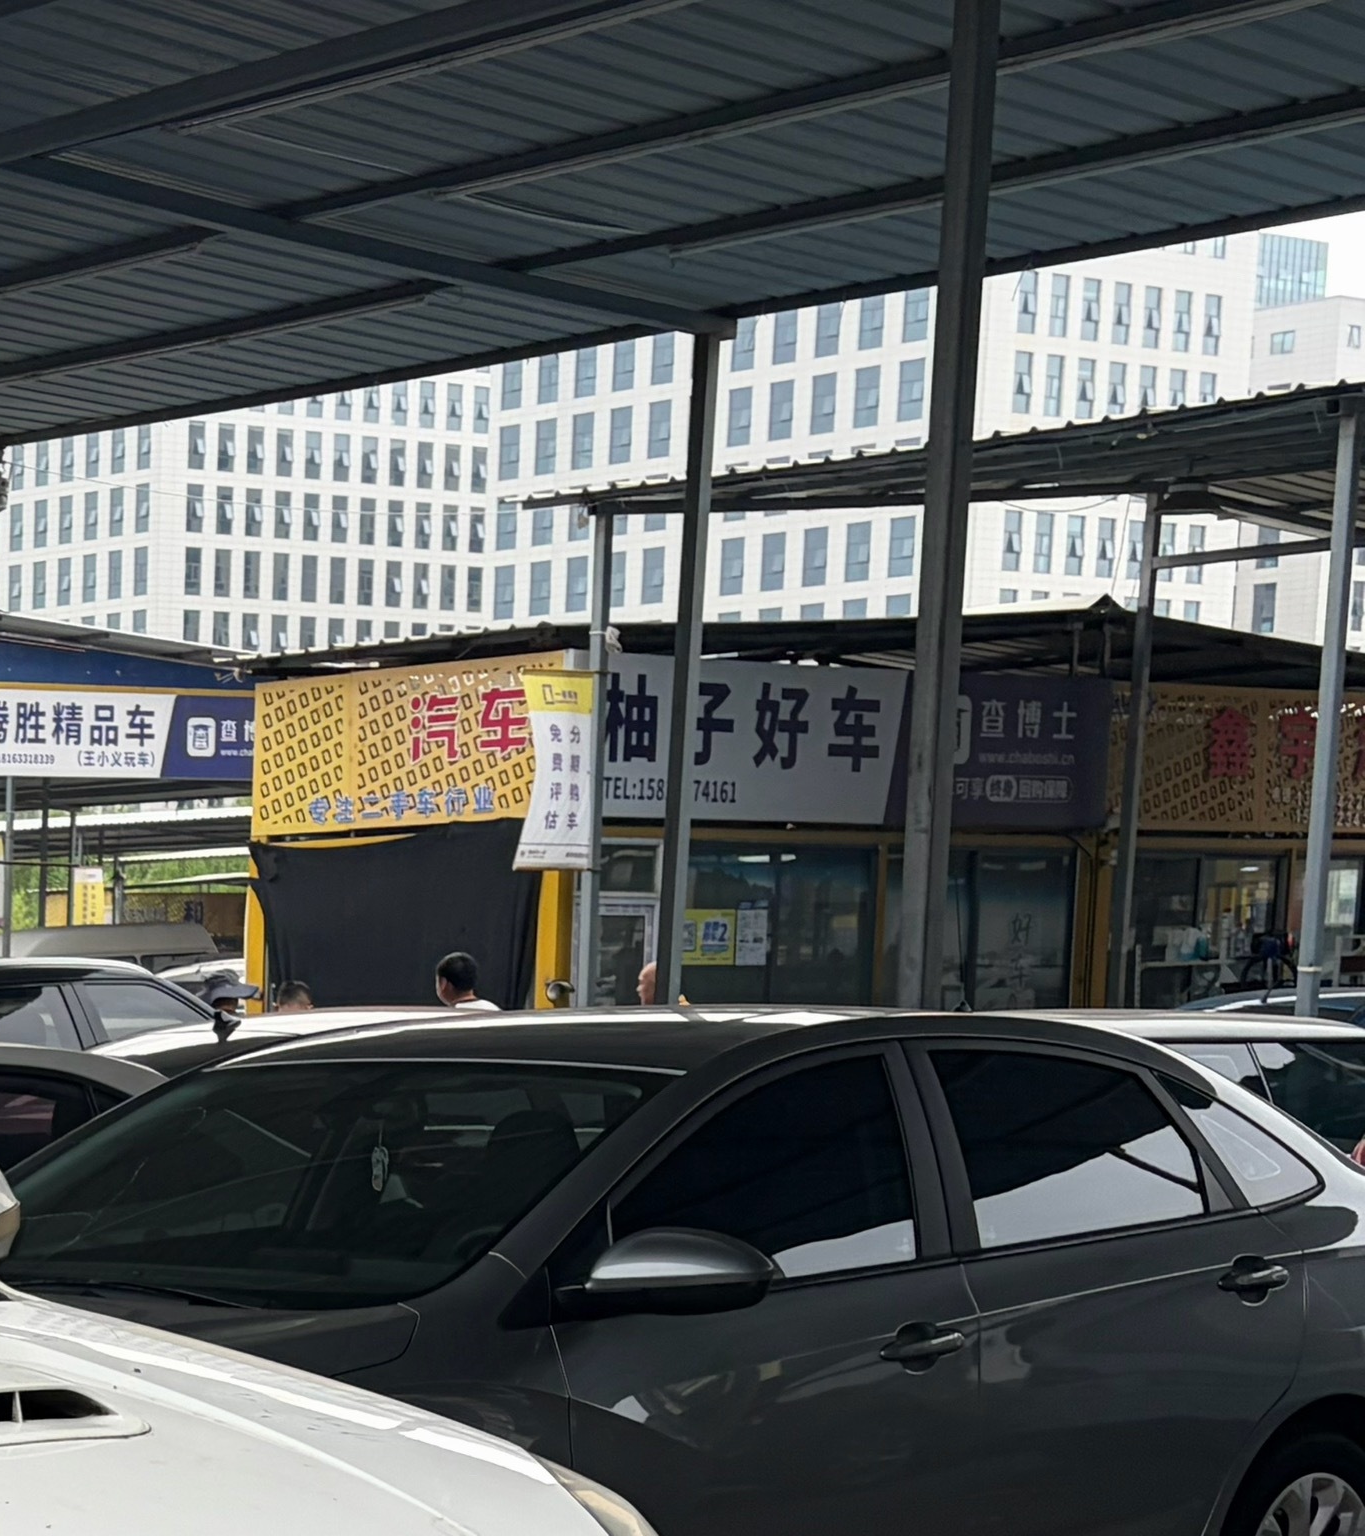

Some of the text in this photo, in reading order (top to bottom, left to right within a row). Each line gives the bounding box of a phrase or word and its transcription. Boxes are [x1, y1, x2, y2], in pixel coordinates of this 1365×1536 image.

[410, 687, 528, 764] 汽车
[606, 672, 881, 772] 柚子好车
[980, 699, 1077, 739] 查博士
[309, 785, 495, 825] 专注二手车行业
[544, 724, 563, 830] 免费评估
